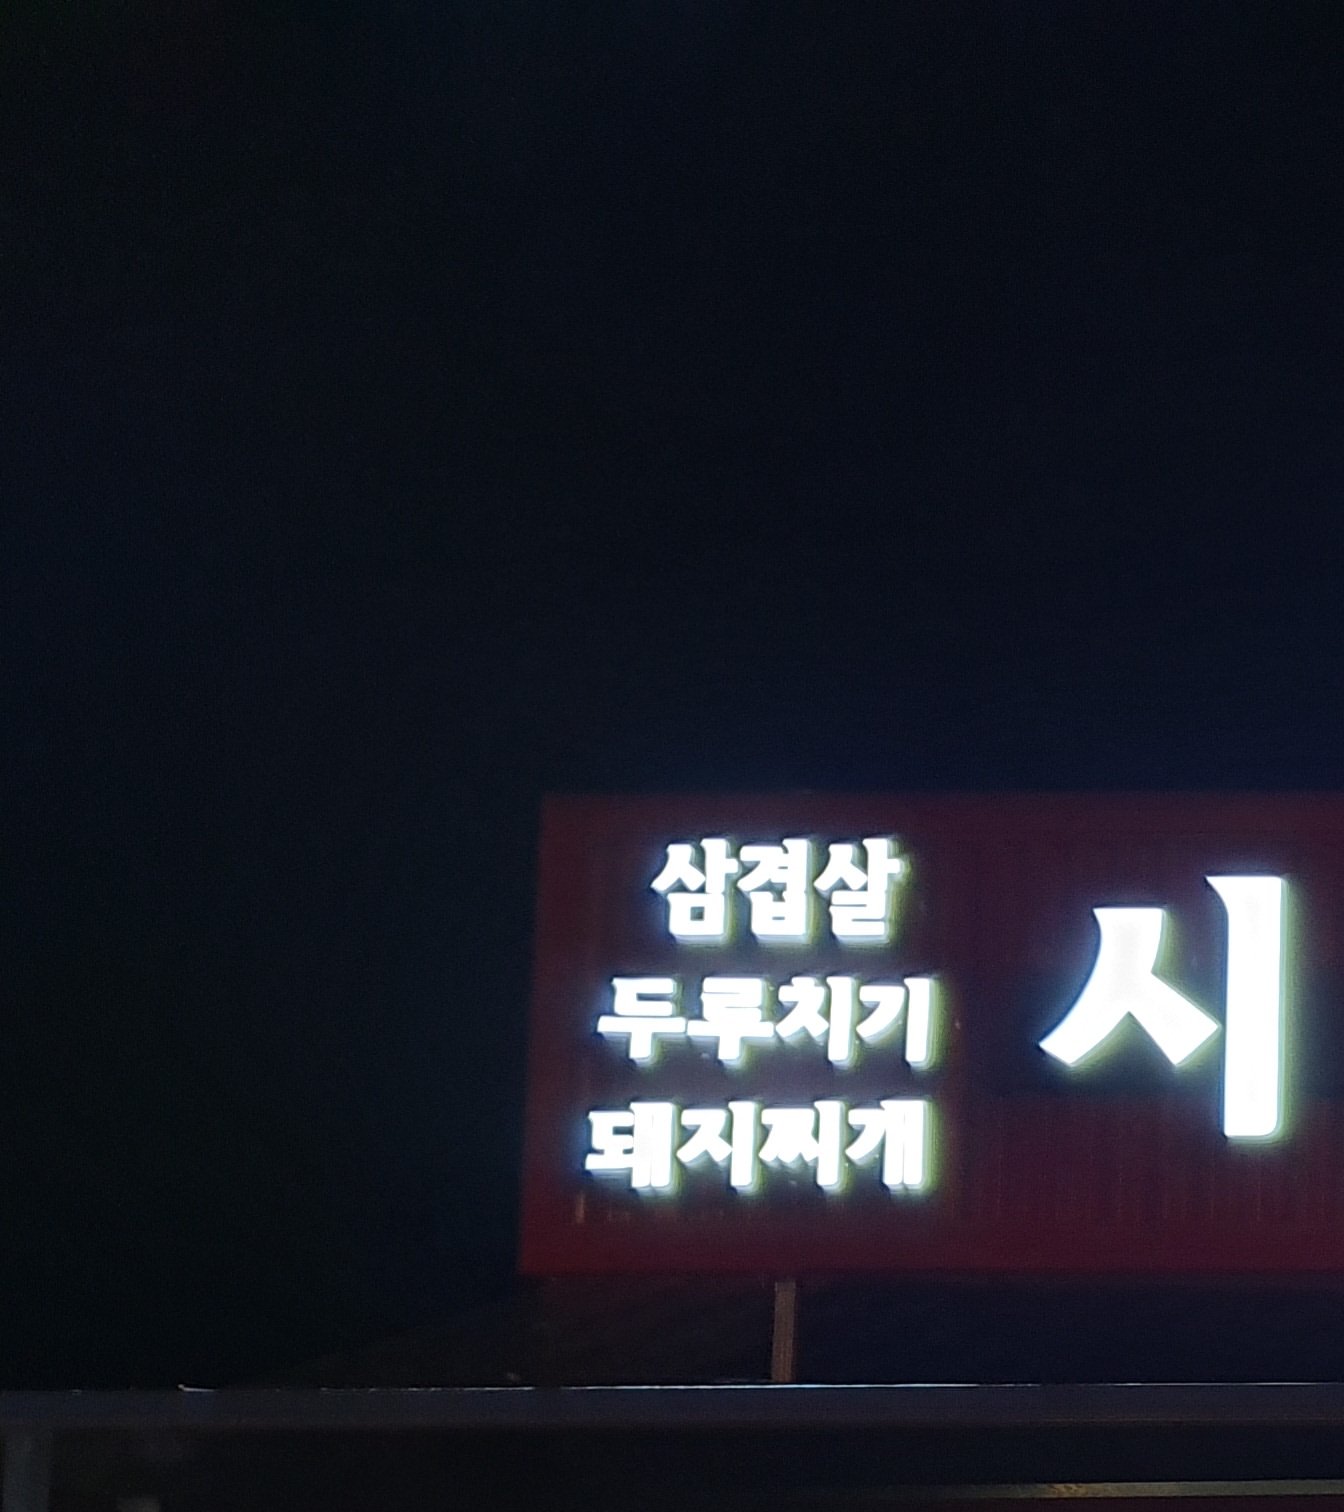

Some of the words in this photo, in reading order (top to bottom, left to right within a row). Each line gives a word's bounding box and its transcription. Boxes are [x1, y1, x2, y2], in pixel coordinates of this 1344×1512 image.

[652, 837, 904, 941] 삼겹살
[597, 975, 934, 1066] 두루치기
[585, 1100, 932, 1190] 돼지찌개
